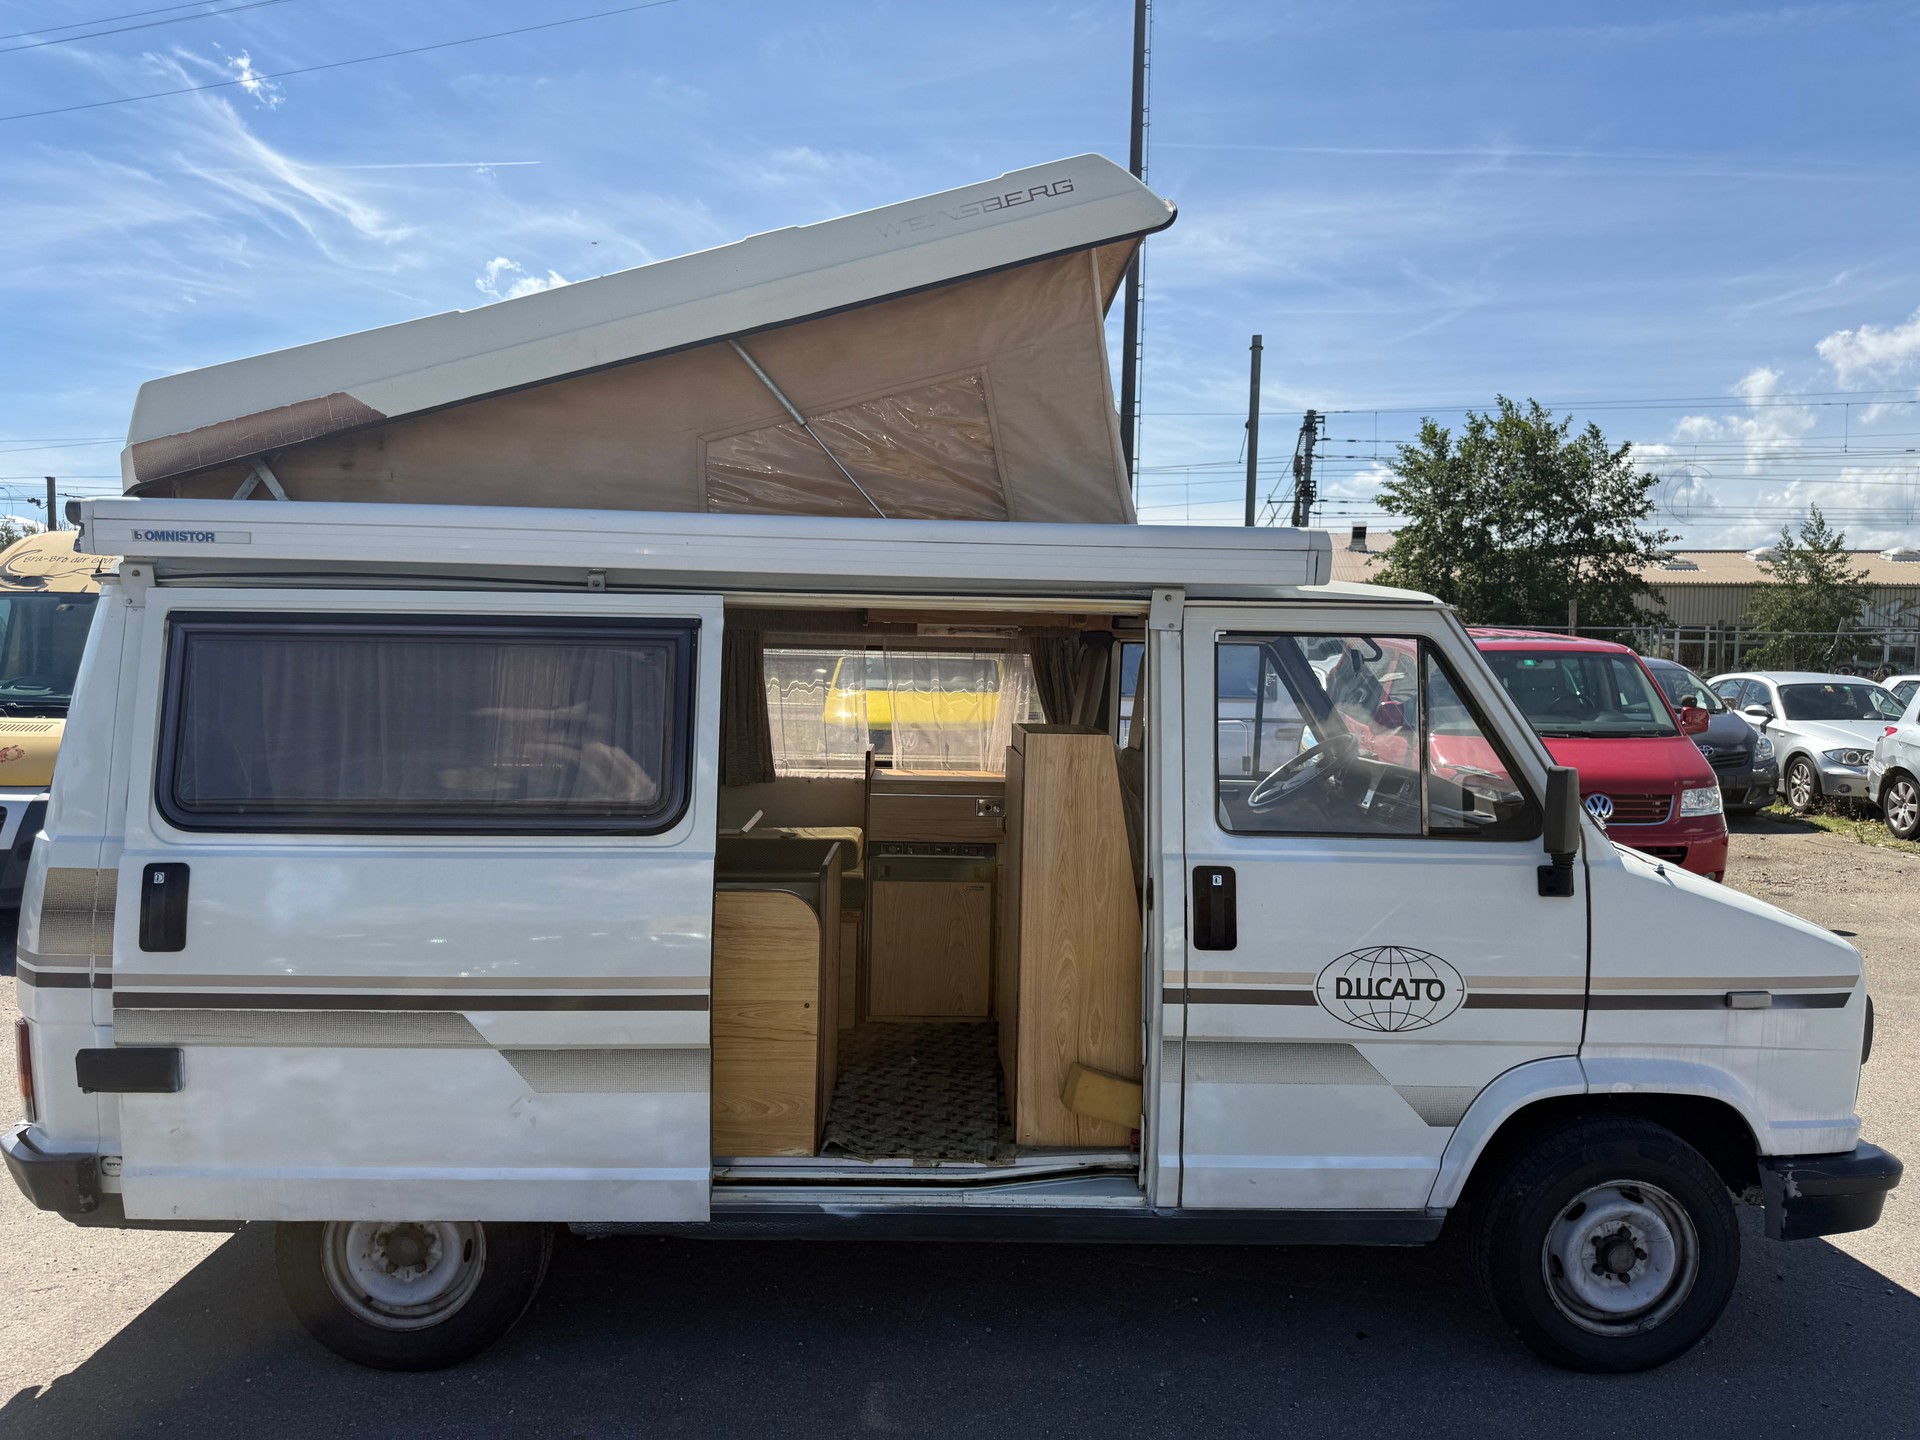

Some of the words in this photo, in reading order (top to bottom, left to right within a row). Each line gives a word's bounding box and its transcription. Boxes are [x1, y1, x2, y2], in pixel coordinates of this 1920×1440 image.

[876, 178, 1075, 238] WENSBERG
[145, 530, 215, 542] OMNISTOR
[1585, 793, 1614, 821] VW
[1335, 977, 1446, 1002] DUCATO
